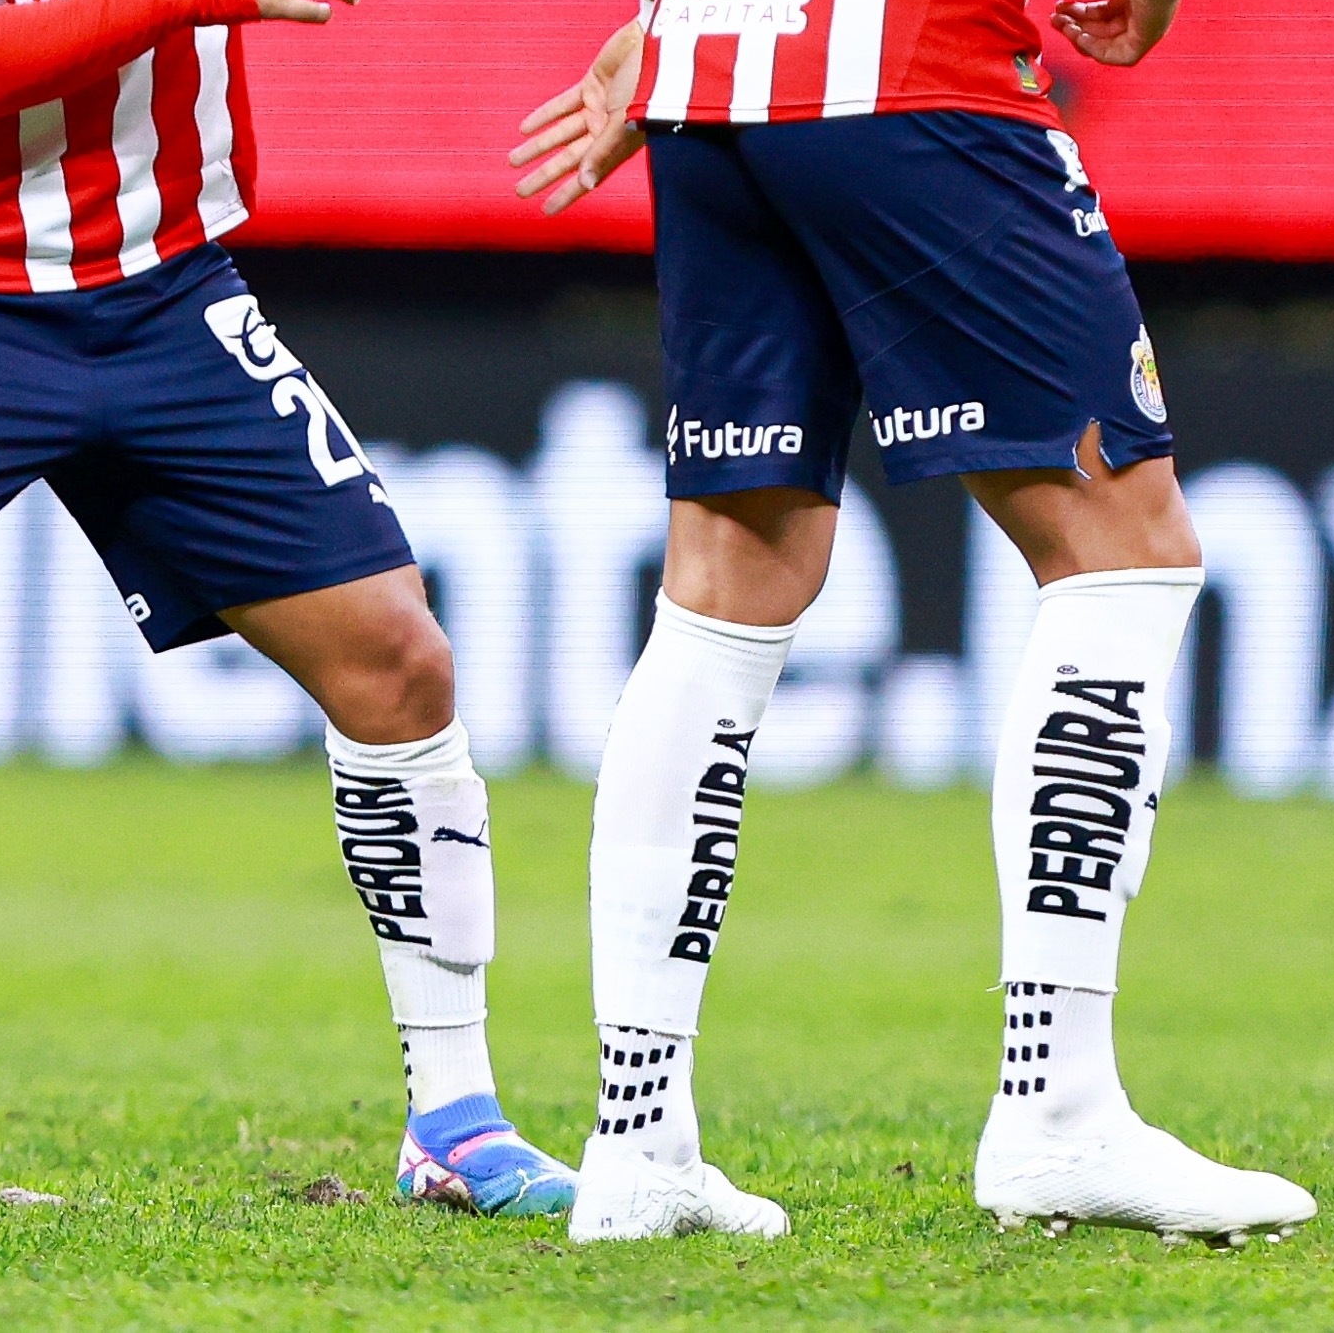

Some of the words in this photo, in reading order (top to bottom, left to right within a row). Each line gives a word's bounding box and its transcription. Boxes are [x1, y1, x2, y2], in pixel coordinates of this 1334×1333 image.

[658, 4, 797, 27] CAPITAL
[271, 372, 377, 487] 2
[683, 420, 803, 459] Futura
[870, 401, 985, 448] utura
[1026, 679, 1146, 923] PERDURA
